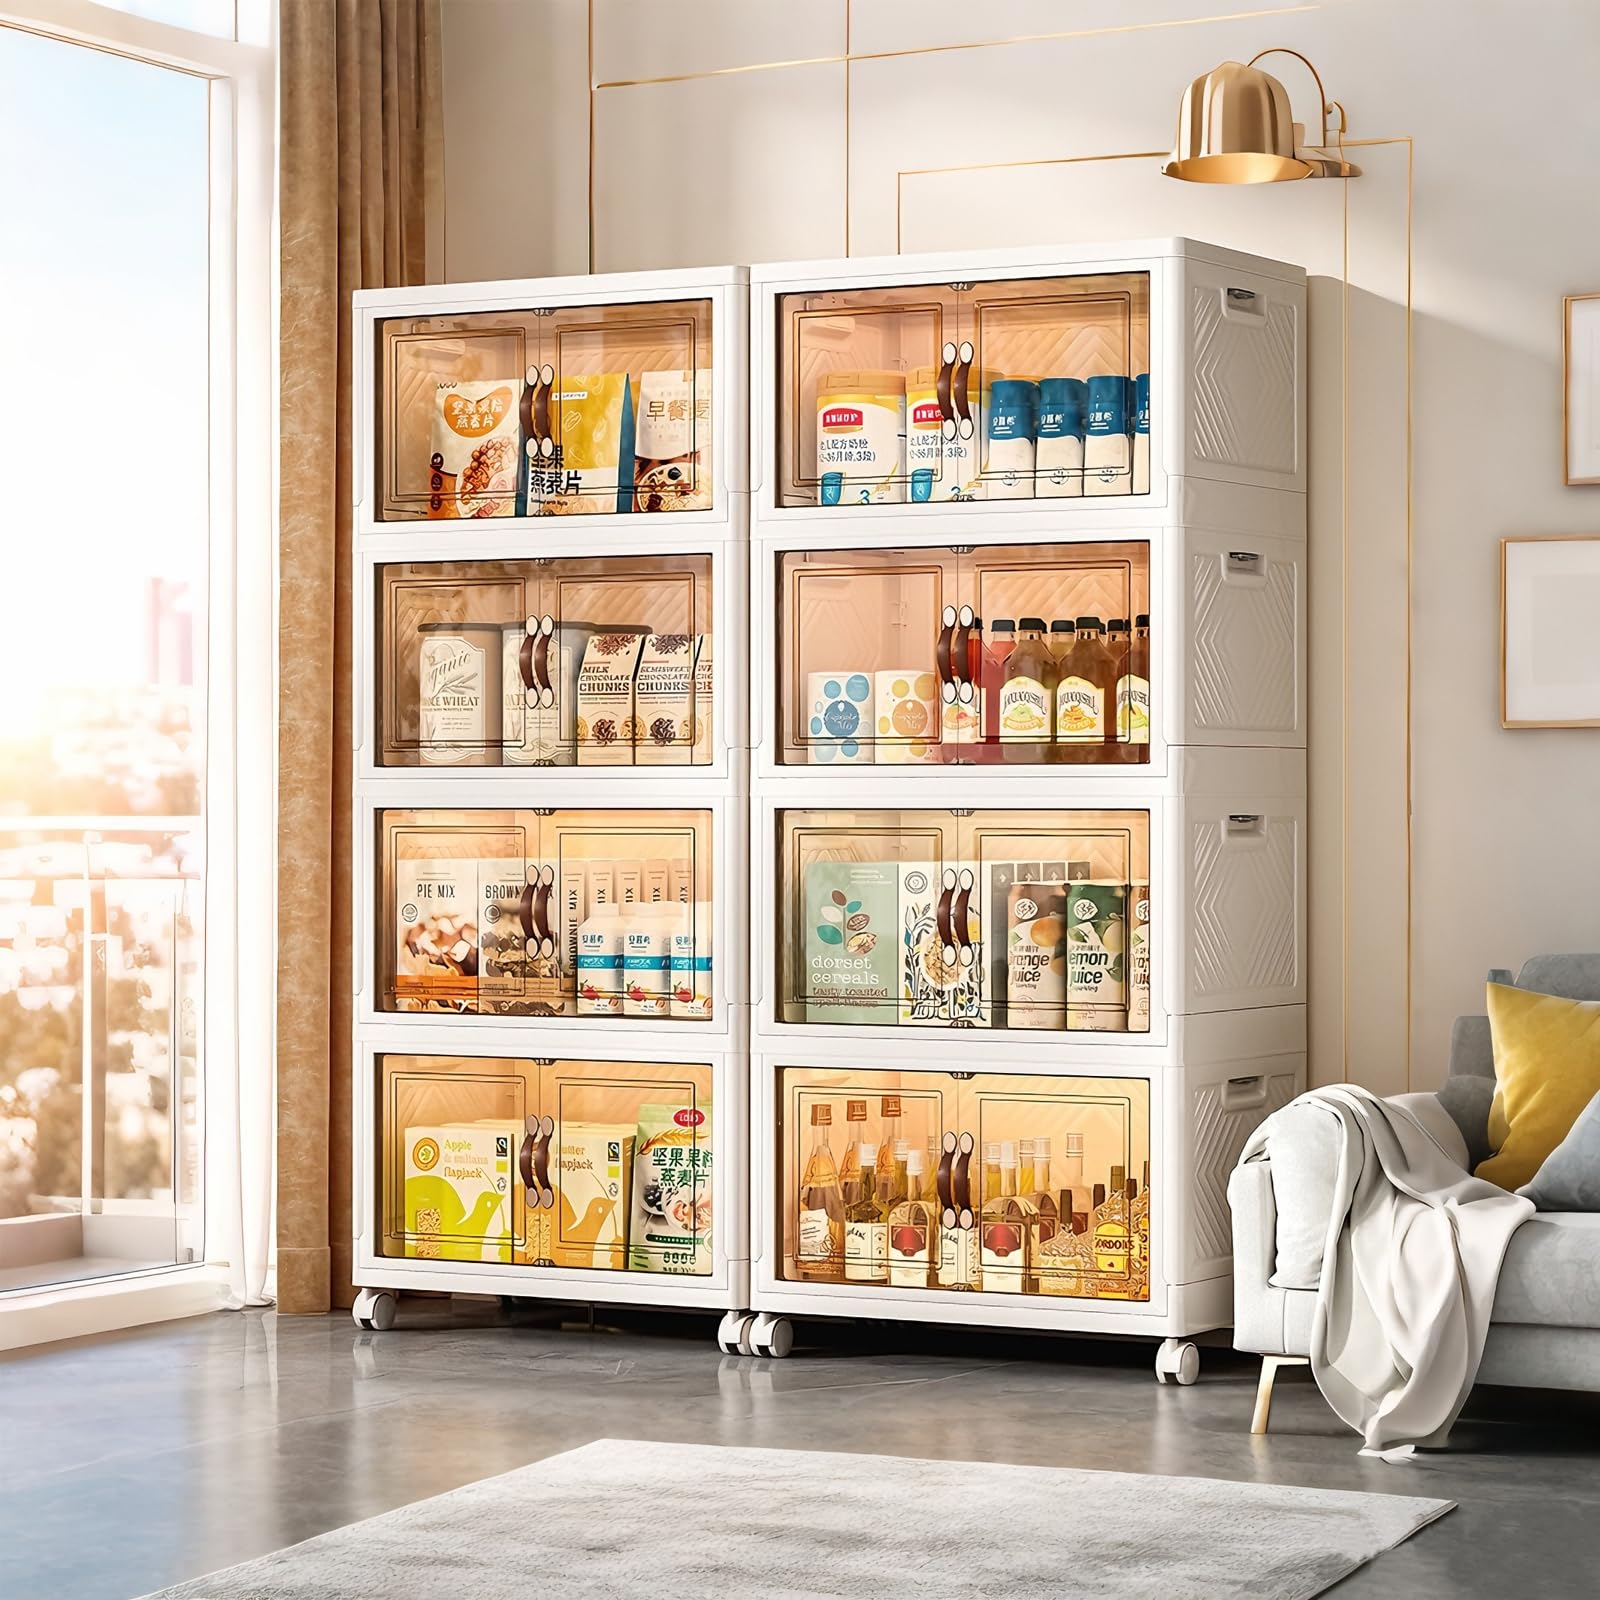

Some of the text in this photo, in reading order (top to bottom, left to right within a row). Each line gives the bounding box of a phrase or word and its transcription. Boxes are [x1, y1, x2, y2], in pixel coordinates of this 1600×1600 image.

[580, 682, 629, 691] CHUNKS
[637, 682, 691, 691] CHUNKS
[442, 696, 480, 706] WHEAT
[417, 884, 456, 898] PIE MIX
[811, 955, 872, 969] dorset
[1068, 952, 1109, 966] emon
[811, 971, 880, 984] cereals
[443, 1139, 472, 1152] Apple
